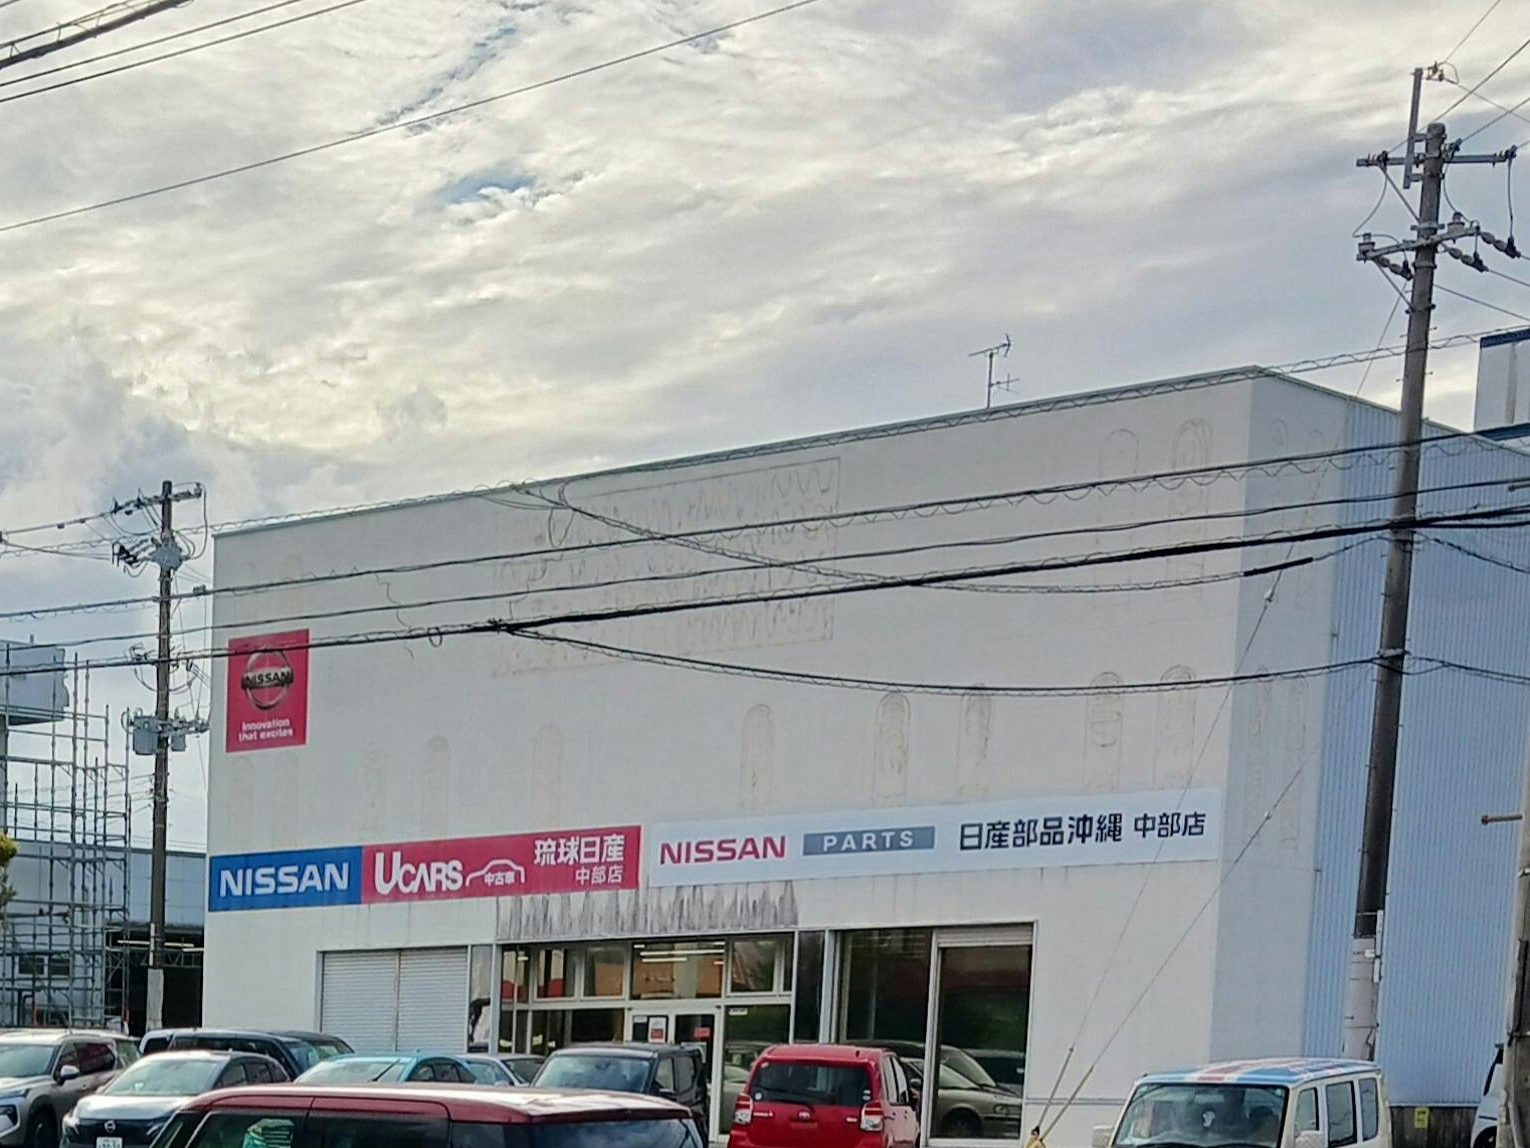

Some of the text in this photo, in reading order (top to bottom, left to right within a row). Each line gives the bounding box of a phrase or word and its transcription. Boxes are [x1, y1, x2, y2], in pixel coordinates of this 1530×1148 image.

[246, 671, 290, 685] NISSAN
[239, 728, 293, 742] that excites
[242, 719, 290, 731] Innovation
[960, 811, 1206, 850] 日産部品沖縄 中部店
[534, 834, 624, 866] 琉球日産
[660, 831, 913, 865] NISSAN PARTS
[220, 862, 349, 897] NISSAN
[484, 871, 516, 886] 中古車
[575, 865, 623, 885] 中部店
